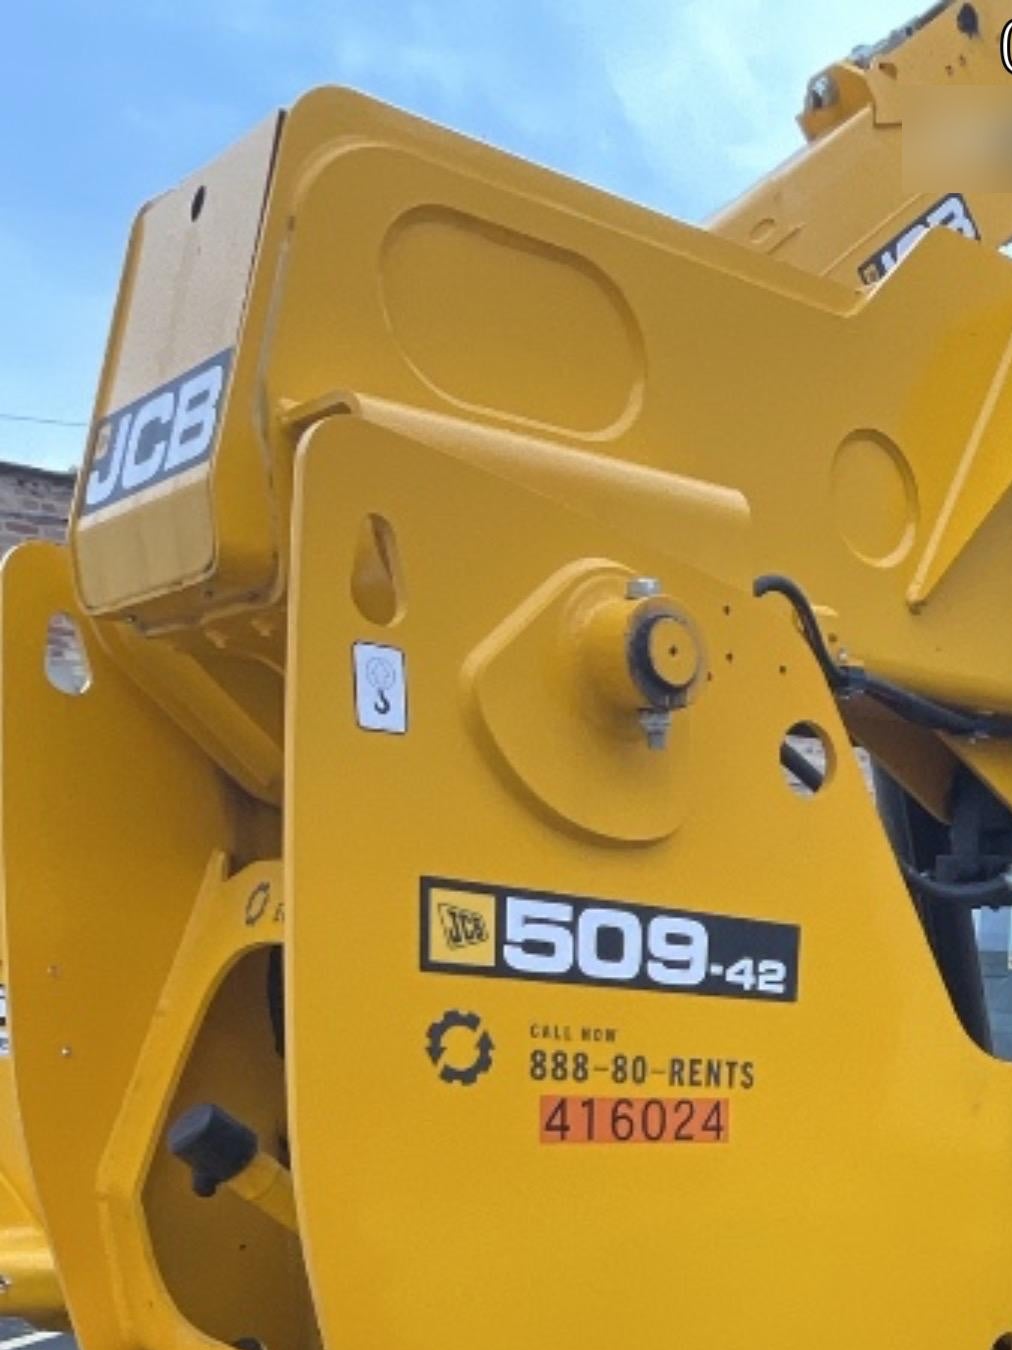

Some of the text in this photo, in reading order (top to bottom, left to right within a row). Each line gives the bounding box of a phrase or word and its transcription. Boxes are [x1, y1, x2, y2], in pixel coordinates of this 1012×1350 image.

[86, 365, 222, 505] JCB
[503, 895, 787, 994] 509-42
[530, 1023, 618, 1043] CALL NOW
[530, 1049, 755, 1089] 888-80-RENTS
[544, 1097, 725, 1141] 416024
